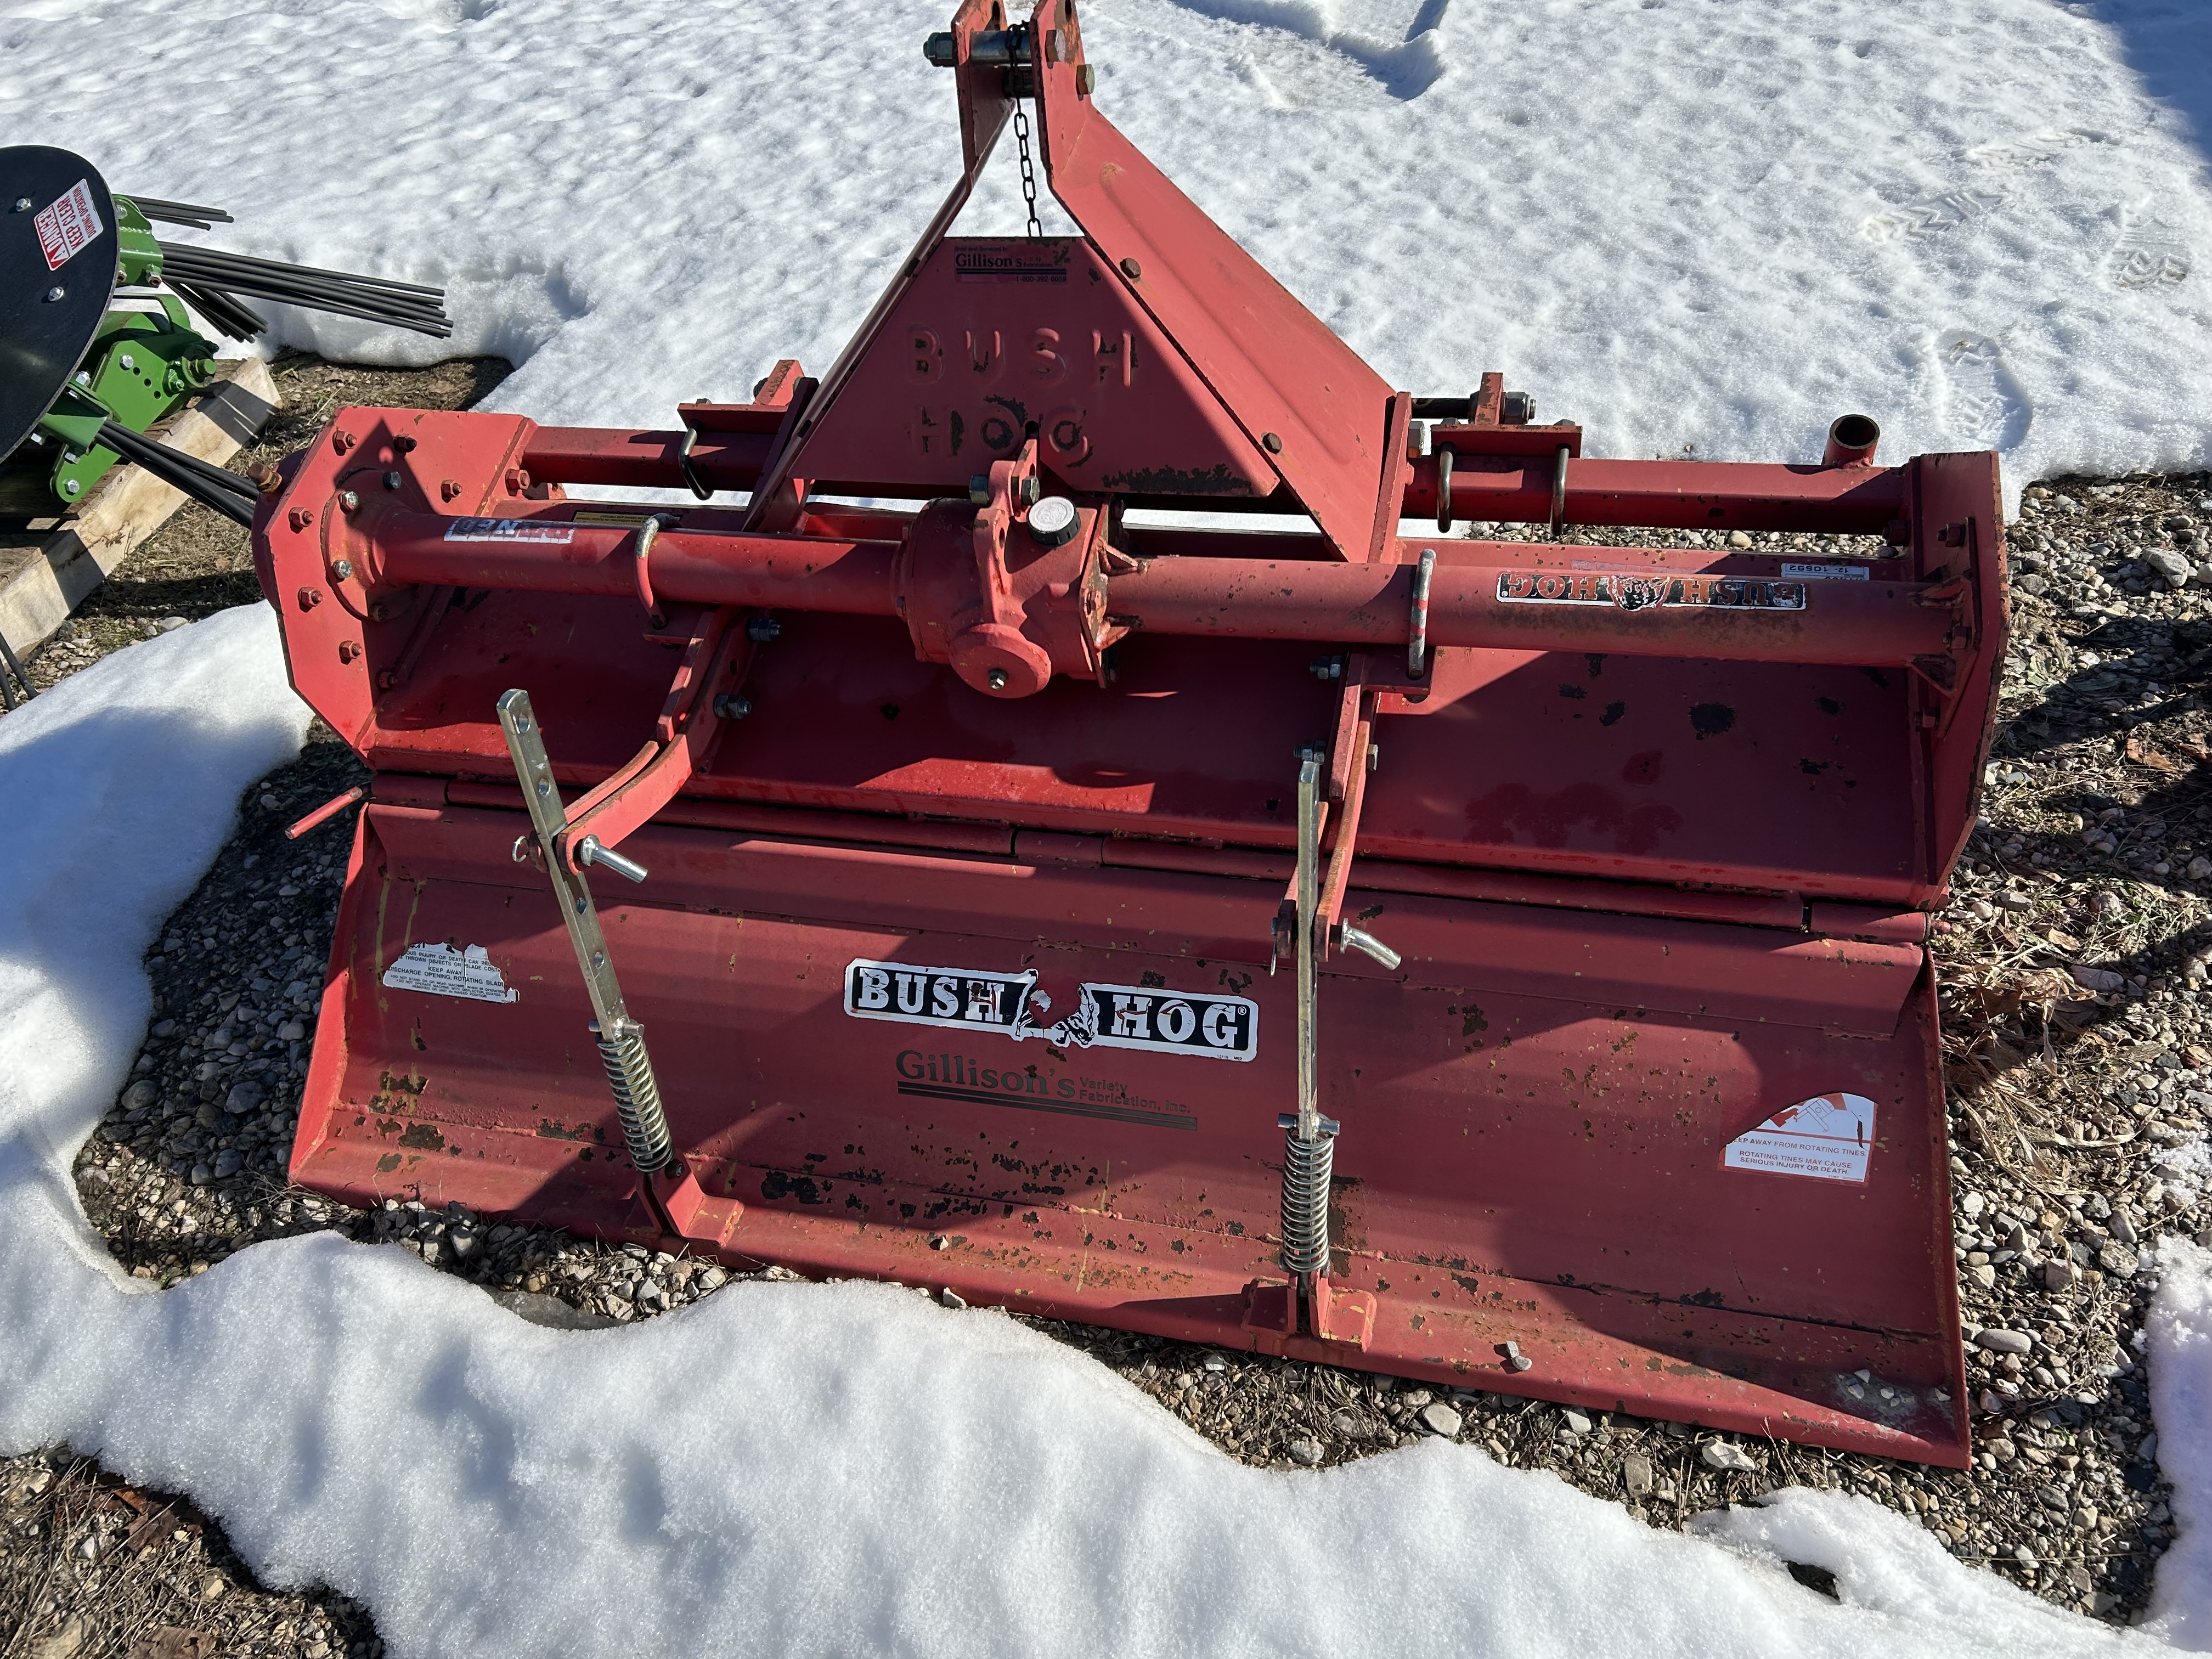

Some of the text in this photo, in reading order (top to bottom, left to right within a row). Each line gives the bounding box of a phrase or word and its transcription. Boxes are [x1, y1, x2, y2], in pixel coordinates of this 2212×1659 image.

[57, 195, 85, 251] KEEP CLEAR
[72, 185, 97, 239] DURING OPERATION
[37, 206, 64, 253] DANGER
[905, 325, 1138, 387] BUSH
[1680, 579, 1801, 607] BUSH
[453, 975, 483, 984] ROTATING
[857, 967, 1005, 1023] BUSH
[895, 1049, 1076, 1098] Gillison's
[1079, 1076, 1128, 1094] Variety
[1079, 1089, 1191, 1114] Fabrication, Inc.
[1739, 1150, 1778, 1160] ROTATING
[1780, 1155, 1803, 1163] TINES
[1824, 1160, 1852, 1169] CAUSE
[1799, 1144, 1839, 1153] ROTATING
[1740, 1156, 1774, 1166] SERIOUS
[1776, 1162, 1805, 1170] INJURY
